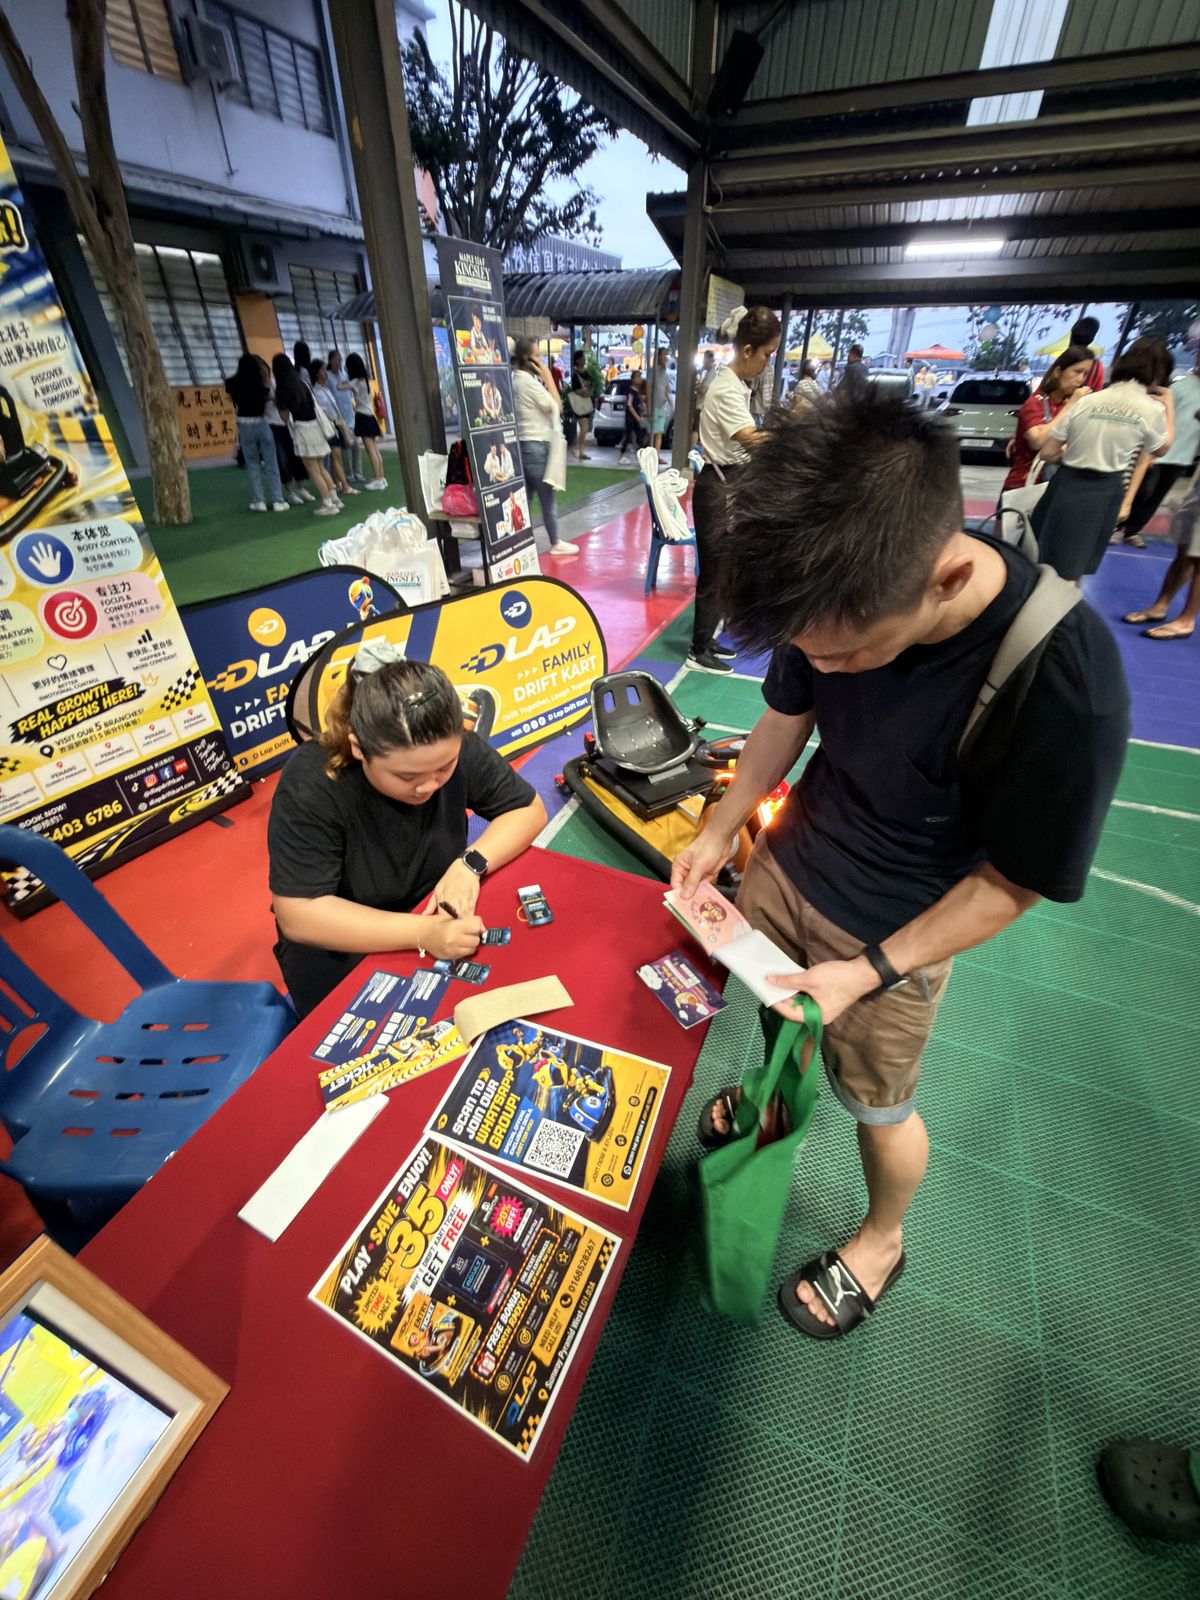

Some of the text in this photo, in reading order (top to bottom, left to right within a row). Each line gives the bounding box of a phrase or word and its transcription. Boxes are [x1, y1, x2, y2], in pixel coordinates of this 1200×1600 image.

[454, 260, 490, 281] KINGSLEY
[31, 367, 63, 385] DISCOVER
[34, 376, 73, 398] A BRIGHTER
[43, 385, 82, 407] TOMORROW!
[71, 525, 111, 541] 本体觉
[77, 536, 135, 552] BODY CONTROL
[96, 581, 132, 597] 专注力
[101, 596, 125, 607] FOCUS
[104, 598, 148, 615] CONFIDENCE
[460, 616, 577, 674] DLAP
[542, 640, 591, 673] FAMILY
[513, 655, 597, 703] DRIFT KART
[17, 682, 110, 735] REAL GROWTH
[39, 683, 140, 738] HAPPENS HERE!
[229, 700, 287, 739] DRIFT
[502, 710, 519, 722] Drift
[547, 697, 589, 721] D Lap Drift Kart
[55, 708, 145, 746] VISIT OUR 5 BRANCHES!
[252, 737, 290, 760] D Lap Drift
[124, 767, 147, 782] FOLLOW
[18, 811, 44, 829] BOOK
[44, 802, 68, 818] NOW!
[85, 799, 123, 826] 6786
[328, 1060, 375, 1094] TICKET
[351, 1057, 392, 1090] ENTRY
[452, 1079, 486, 1136] SCAN TO
[466, 1078, 500, 1140] JOIN OUR
[475, 1069, 514, 1145] WHATSAPP
[488, 1092, 521, 1150] GROUP!
[503, 1129, 514, 1154] SPECIAL
[509, 1124, 524, 1156] EXCLUSIVE
[592, 1164, 600, 1183] JOIN
[598, 1150, 606, 1167] NOW
[340, 1147, 433, 1295] PLAY SAVE ENJOY!
[379, 1163, 461, 1278] RM 35 ONLY!
[496, 1203, 511, 1227] 20%
[505, 1207, 519, 1229] OFF!
[410, 1274, 420, 1291] BUY
[423, 1245, 436, 1268] DRIFT
[435, 1228, 446, 1246] KART
[444, 1204, 459, 1228] TICKET
[422, 1208, 468, 1287] GET FREE
[520, 1269, 529, 1283] ONE
[526, 1266, 536, 1286] THREE
[568, 1239, 596, 1293] 0168528267
[362, 1284, 379, 1315] LIMITED
[369, 1291, 385, 1315] TIME
[377, 1295, 392, 1320] ONLY!
[413, 1301, 428, 1329] ENTRY
[420, 1303, 435, 1332] TICKET
[487, 1288, 521, 1352] FREE BONUS
[494, 1325, 511, 1357] WORTH
[508, 1293, 529, 1328] RMXX!
[539, 1308, 560, 1349] NEED HELP?
[545, 1322, 563, 1353] CALL US!
[545, 1357, 564, 1390] Sunway
[557, 1328, 576, 1360] Pyramid
[570, 1310, 584, 1331] West
